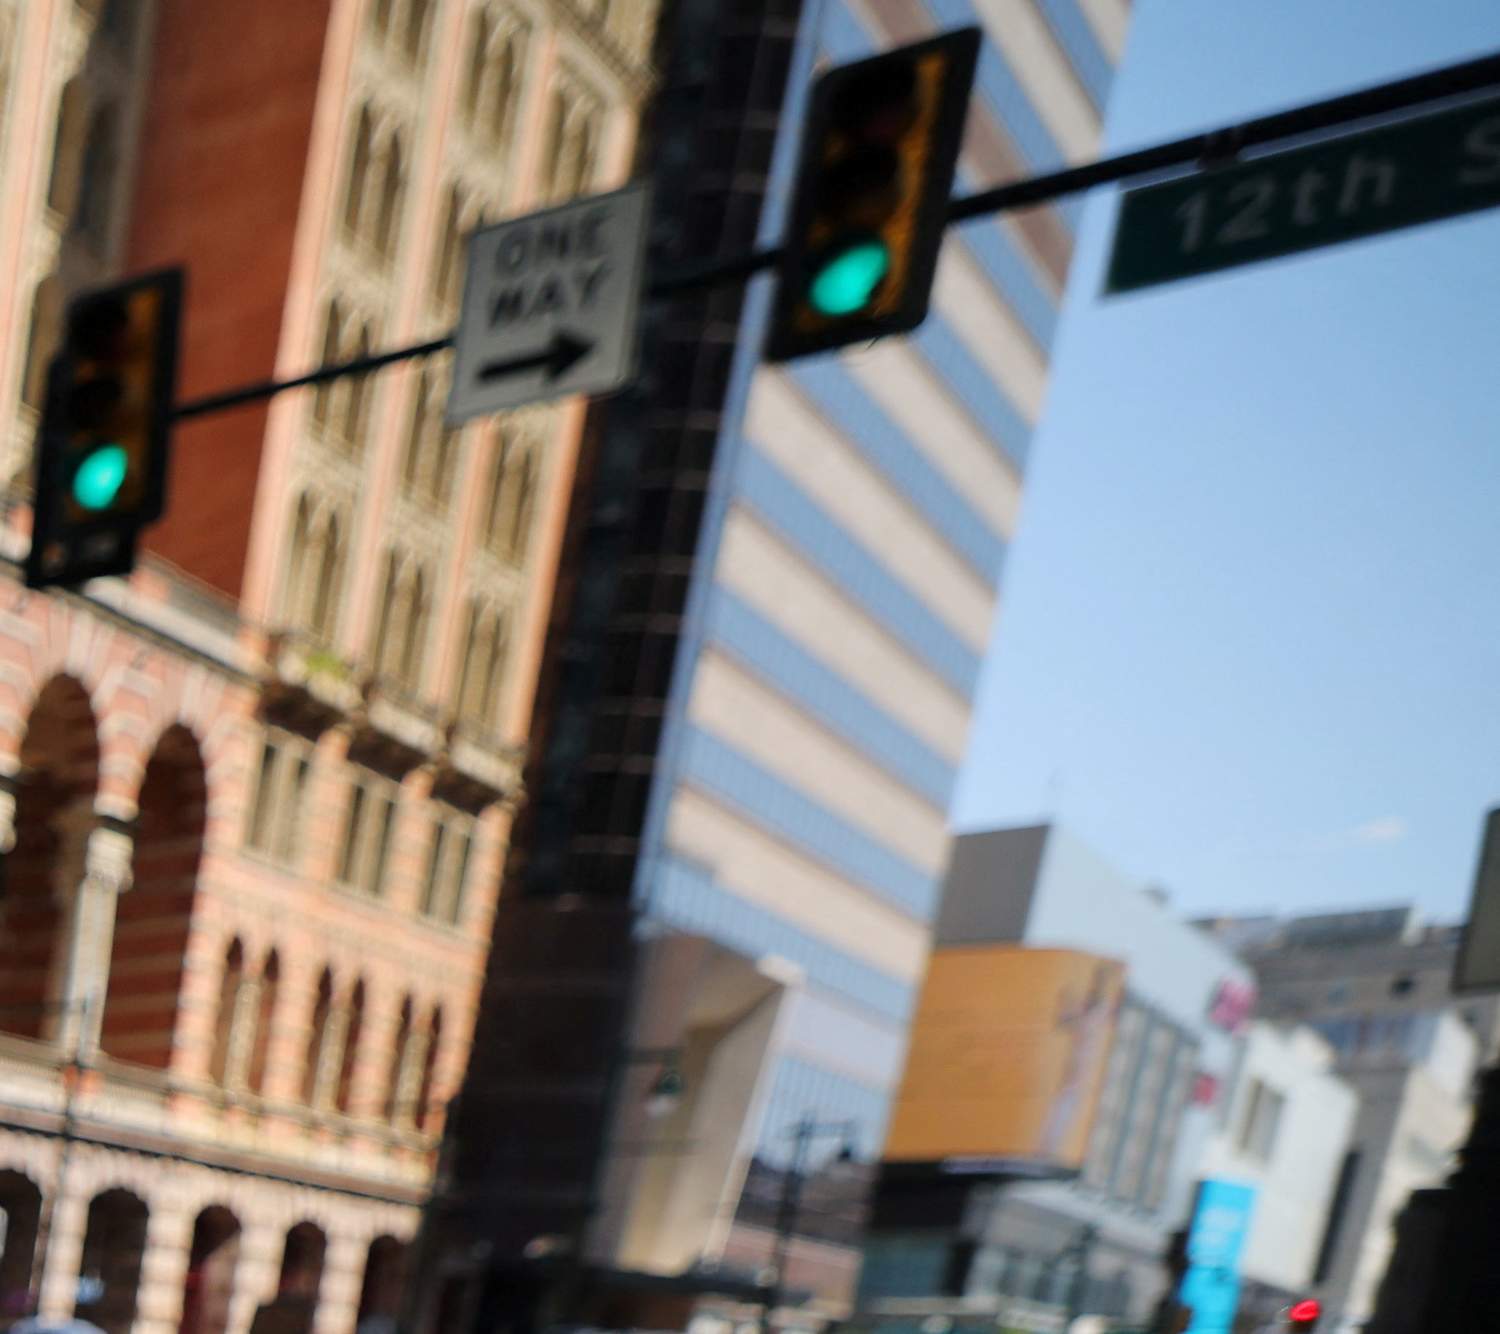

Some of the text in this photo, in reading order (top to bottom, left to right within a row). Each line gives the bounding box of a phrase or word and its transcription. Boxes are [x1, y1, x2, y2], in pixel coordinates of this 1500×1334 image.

[1173, 114, 1500, 255] 12th S
[495, 206, 612, 276] ONE
[487, 260, 612, 331] WAY
